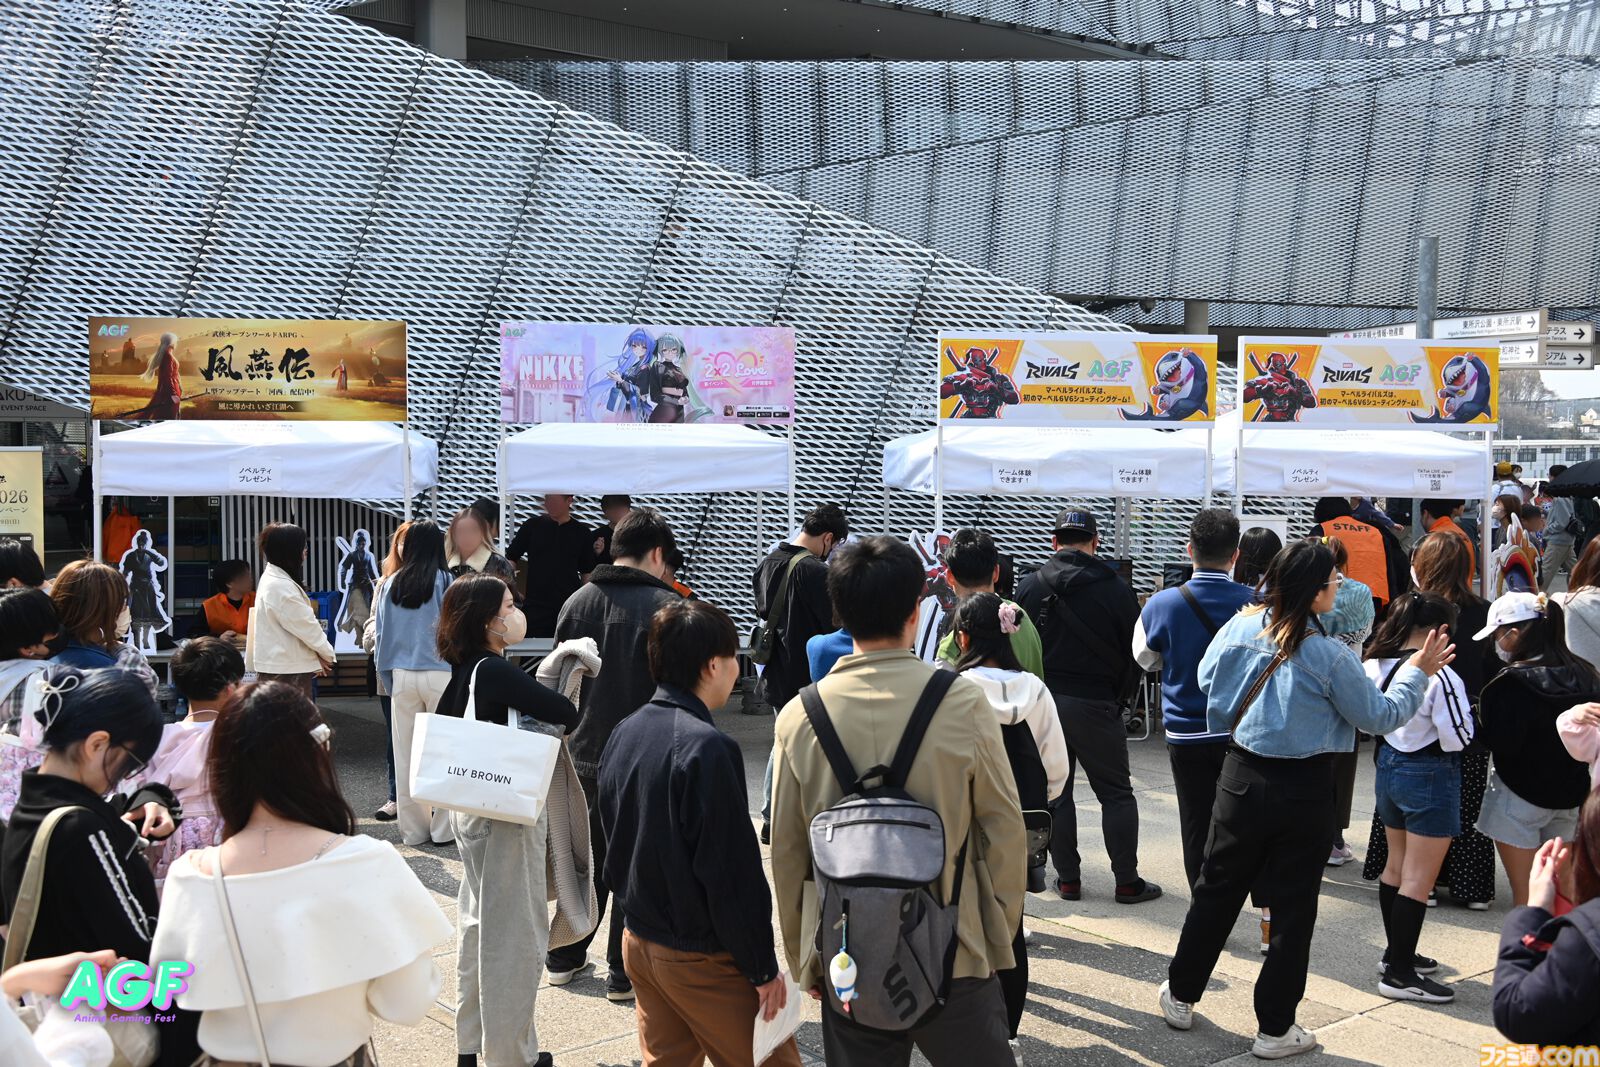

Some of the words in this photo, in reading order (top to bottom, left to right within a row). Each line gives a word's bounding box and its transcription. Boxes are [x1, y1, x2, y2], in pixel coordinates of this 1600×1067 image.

[98, 324, 129, 336] AGF
[199, 345, 315, 382] 風燕伝
[520, 355, 584, 380] NIKKE
[1026, 361, 1080, 379] RIVALS
[1088, 360, 1133, 378] AGF
[735, 363, 768, 378] Love
[1323, 365, 1373, 384] RIVALS
[1379, 364, 1422, 382] AGF
[239, 467, 272, 475] ノベルティ
[998, 468, 1032, 476] ゲーム体験
[1118, 468, 1152, 476] ゲーム体験
[239, 475, 272, 483] プレゼント
[1333, 523, 1370, 532] STAFF
[447, 766, 468, 776] LILY
[470, 770, 512, 785] BROWN
